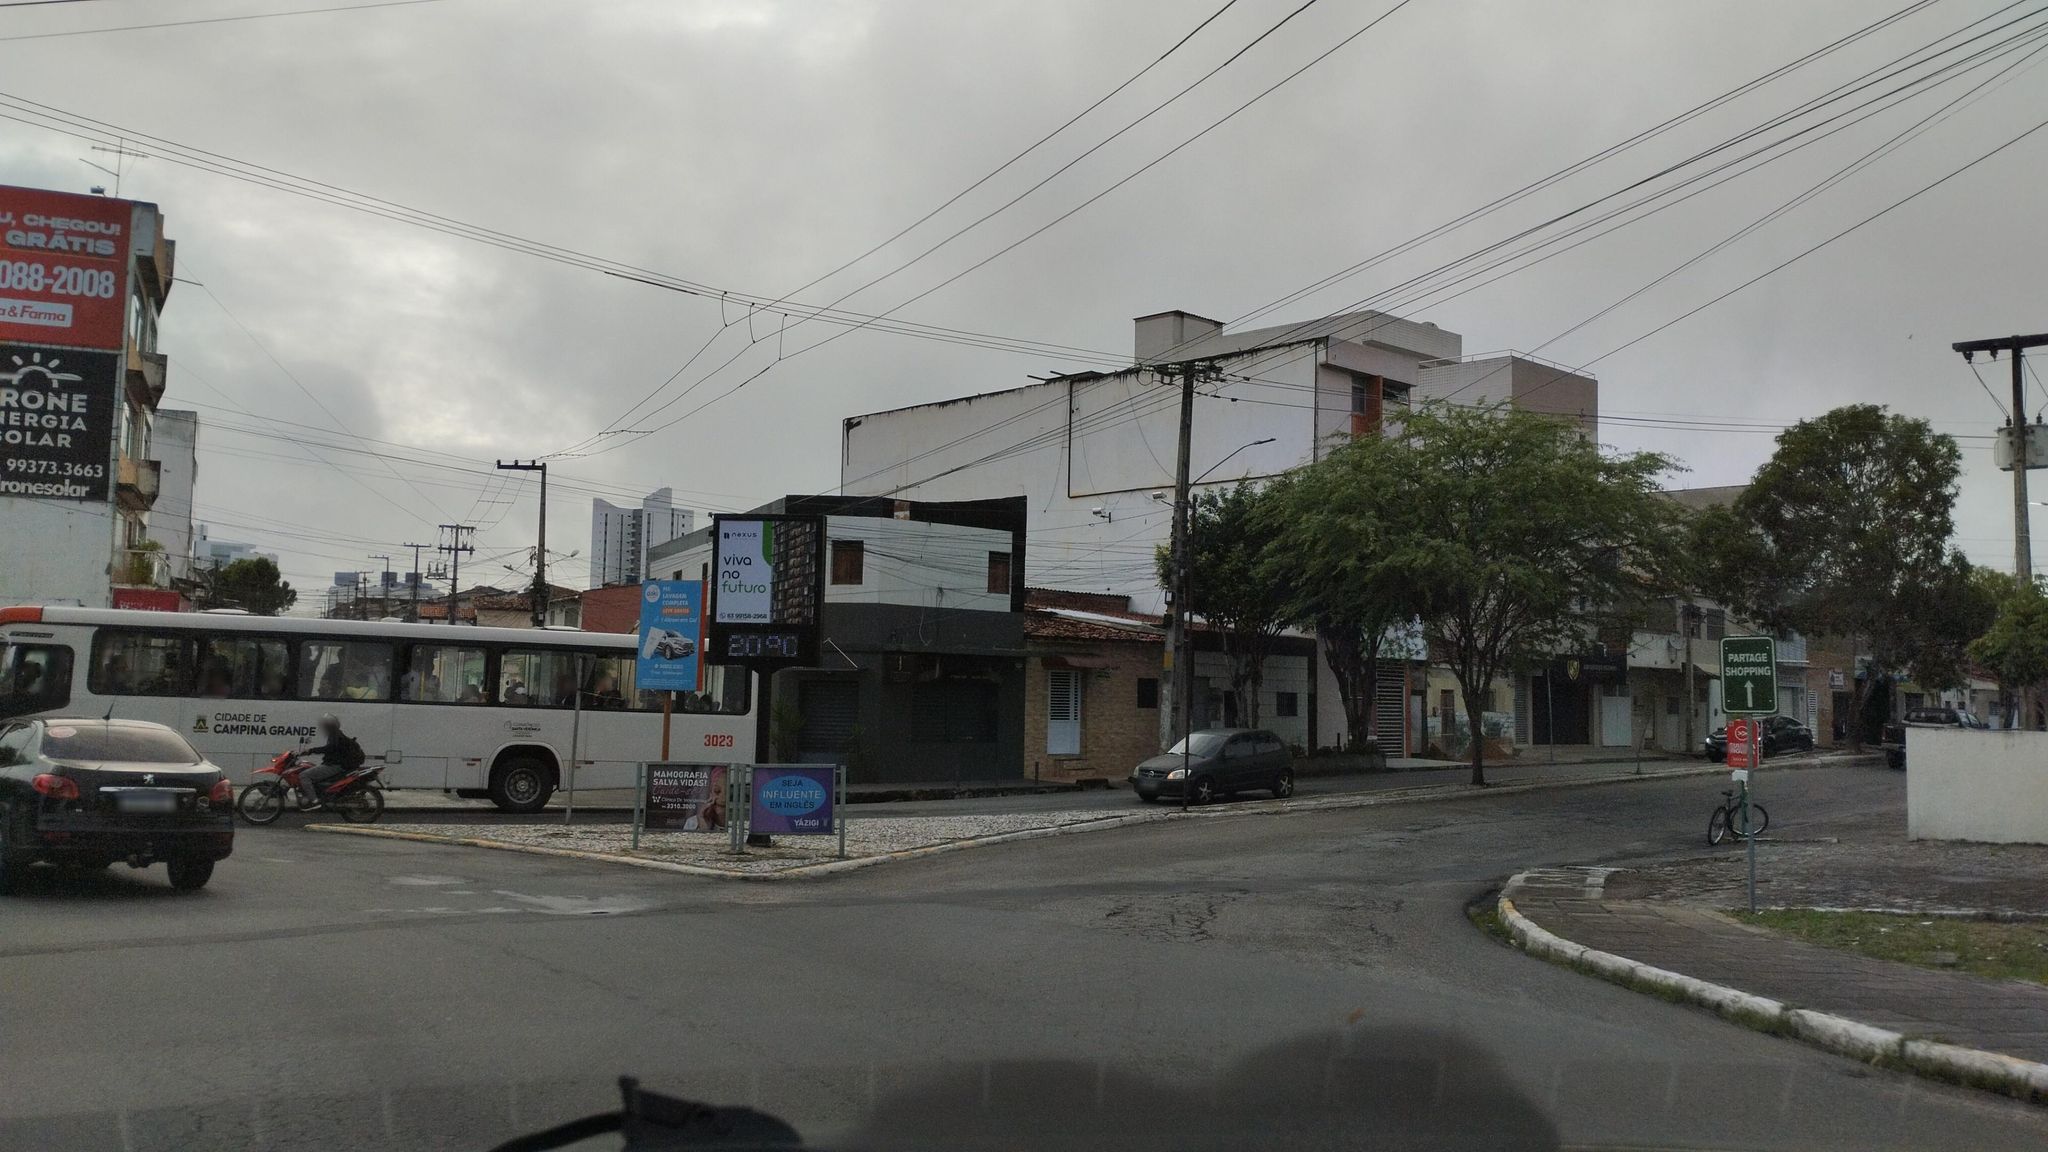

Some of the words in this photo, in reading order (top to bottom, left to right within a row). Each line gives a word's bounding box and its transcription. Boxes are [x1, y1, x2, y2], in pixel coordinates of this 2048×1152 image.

[23, 214, 121, 236] CHEGOU!
[5, 230, 116, 256] GRÁTIS
[20, 305, 66, 322] Farma
[0, 430, 72, 448] OLAR
[7, 458, 103, 478] 99373.3663
[723, 553, 752, 566] viva
[722, 570, 740, 579] no
[722, 580, 766, 594] futuro
[1728, 653, 1768, 663] PARTAGE
[1725, 666, 1772, 676] SHOPPING
[214, 713, 251, 722] CIDADE
[253, 714, 267, 723] DE
[213, 724, 267, 736] CAMPINA
[268, 726, 316, 737] GRANDE
[704, 734, 733, 747] 3023
[653, 770, 708, 779] MAMOGRAFIA
[652, 778, 678, 786] SALVA
[680, 779, 707, 787] VIDAS!
[762, 790, 821, 799] INFLUENTE
[769, 801, 782, 809] EM
